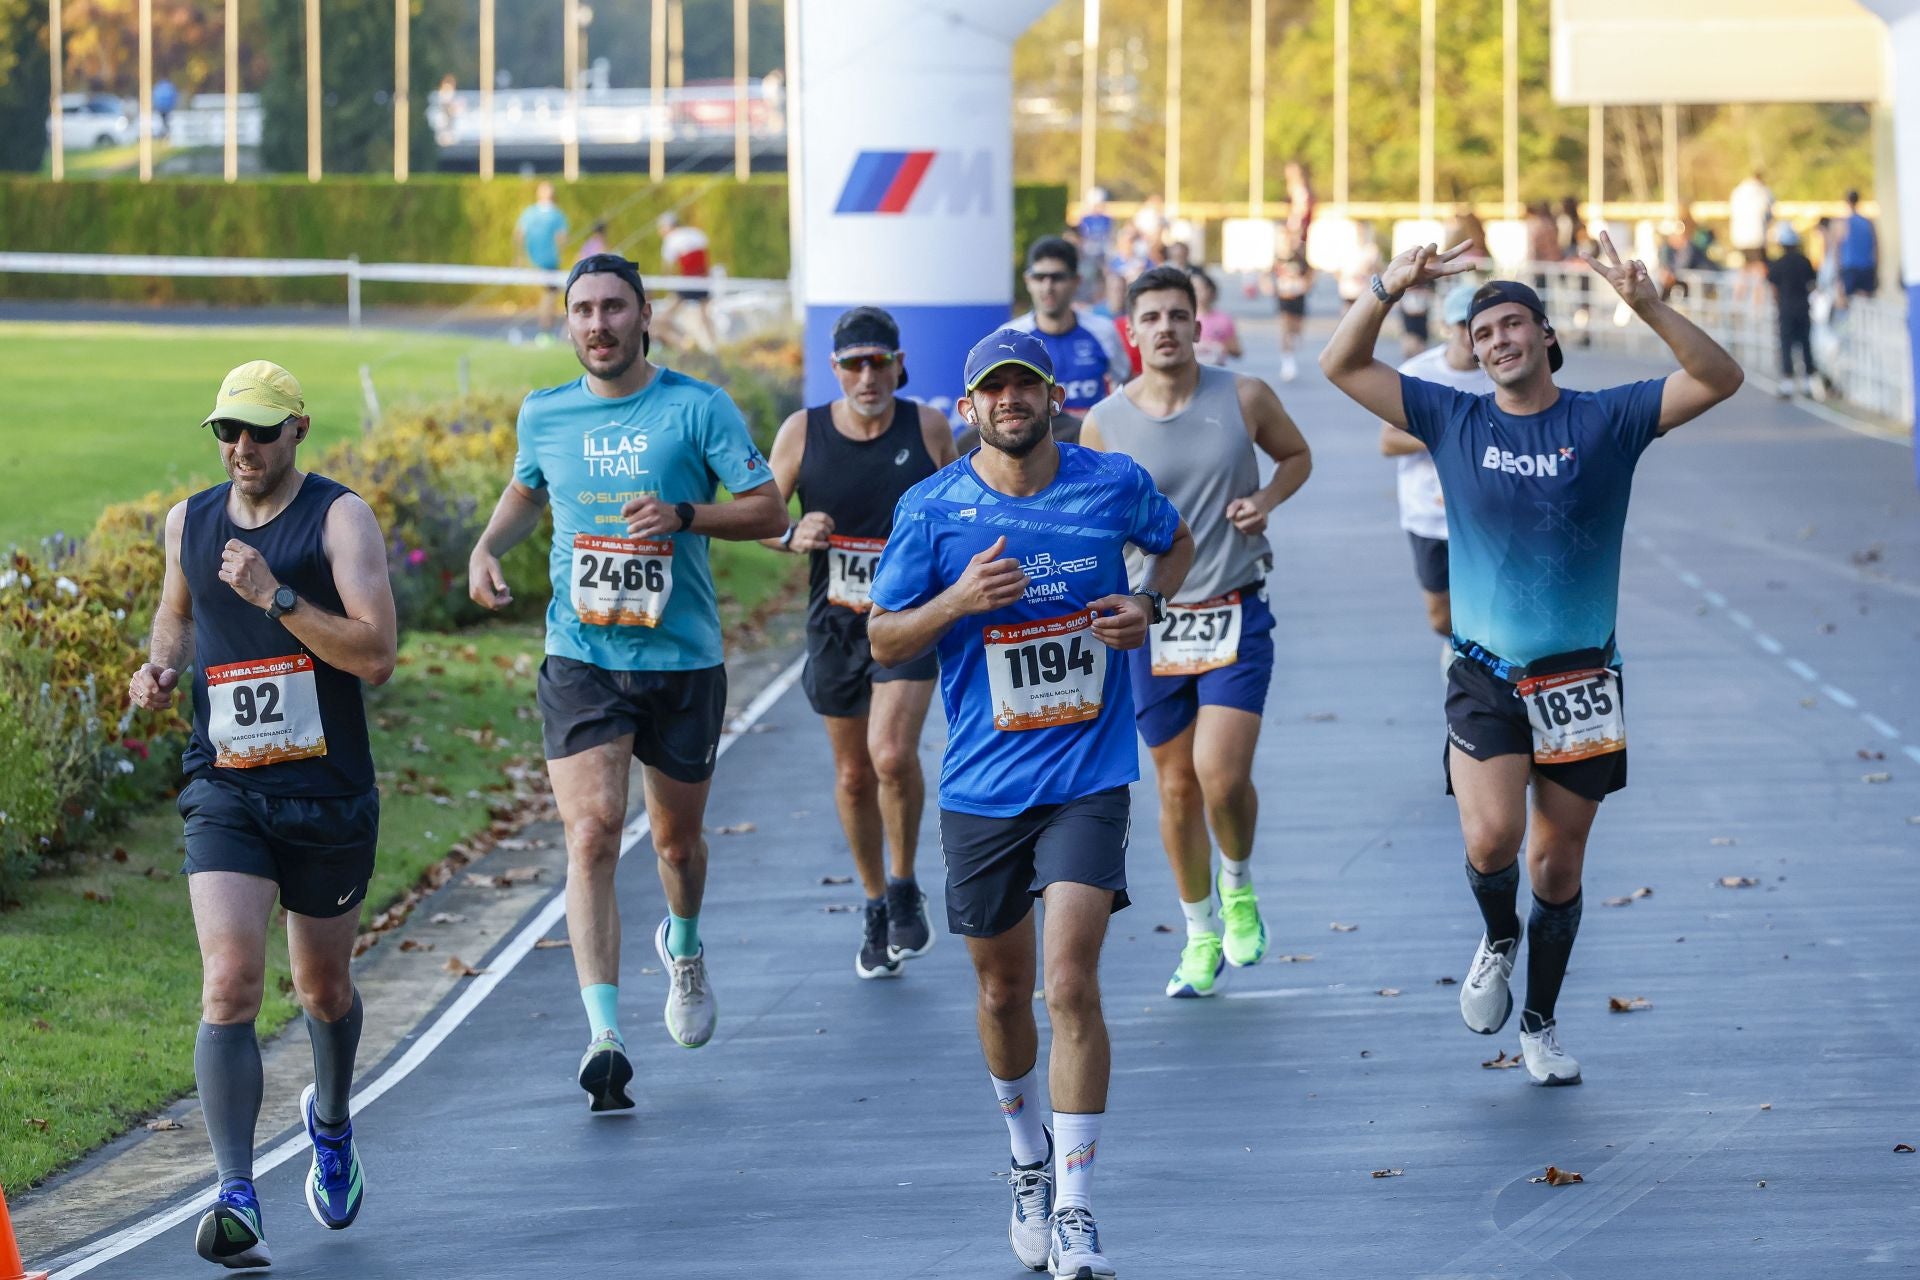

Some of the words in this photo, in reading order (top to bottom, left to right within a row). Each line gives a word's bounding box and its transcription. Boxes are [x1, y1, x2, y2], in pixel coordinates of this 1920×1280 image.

[583, 454, 649, 479] TRAIL
[580, 554, 664, 593] 2466
[1021, 581, 1069, 598] AMBAR
[1028, 596, 1047, 604] TRIPLE
[1021, 625, 1047, 637] MBA
[1066, 615, 1088, 629] GIJÓN
[1160, 609, 1232, 642] 2237
[230, 667, 252, 677] MBA
[269, 661, 294, 672] GIJÓN
[1005, 636, 1094, 689] 1194
[233, 682, 284, 727] 92
[1030, 692, 1054, 700] DANIEL
[1054, 687, 1080, 696] MOLINA
[1533, 679, 1613, 730] 1835
